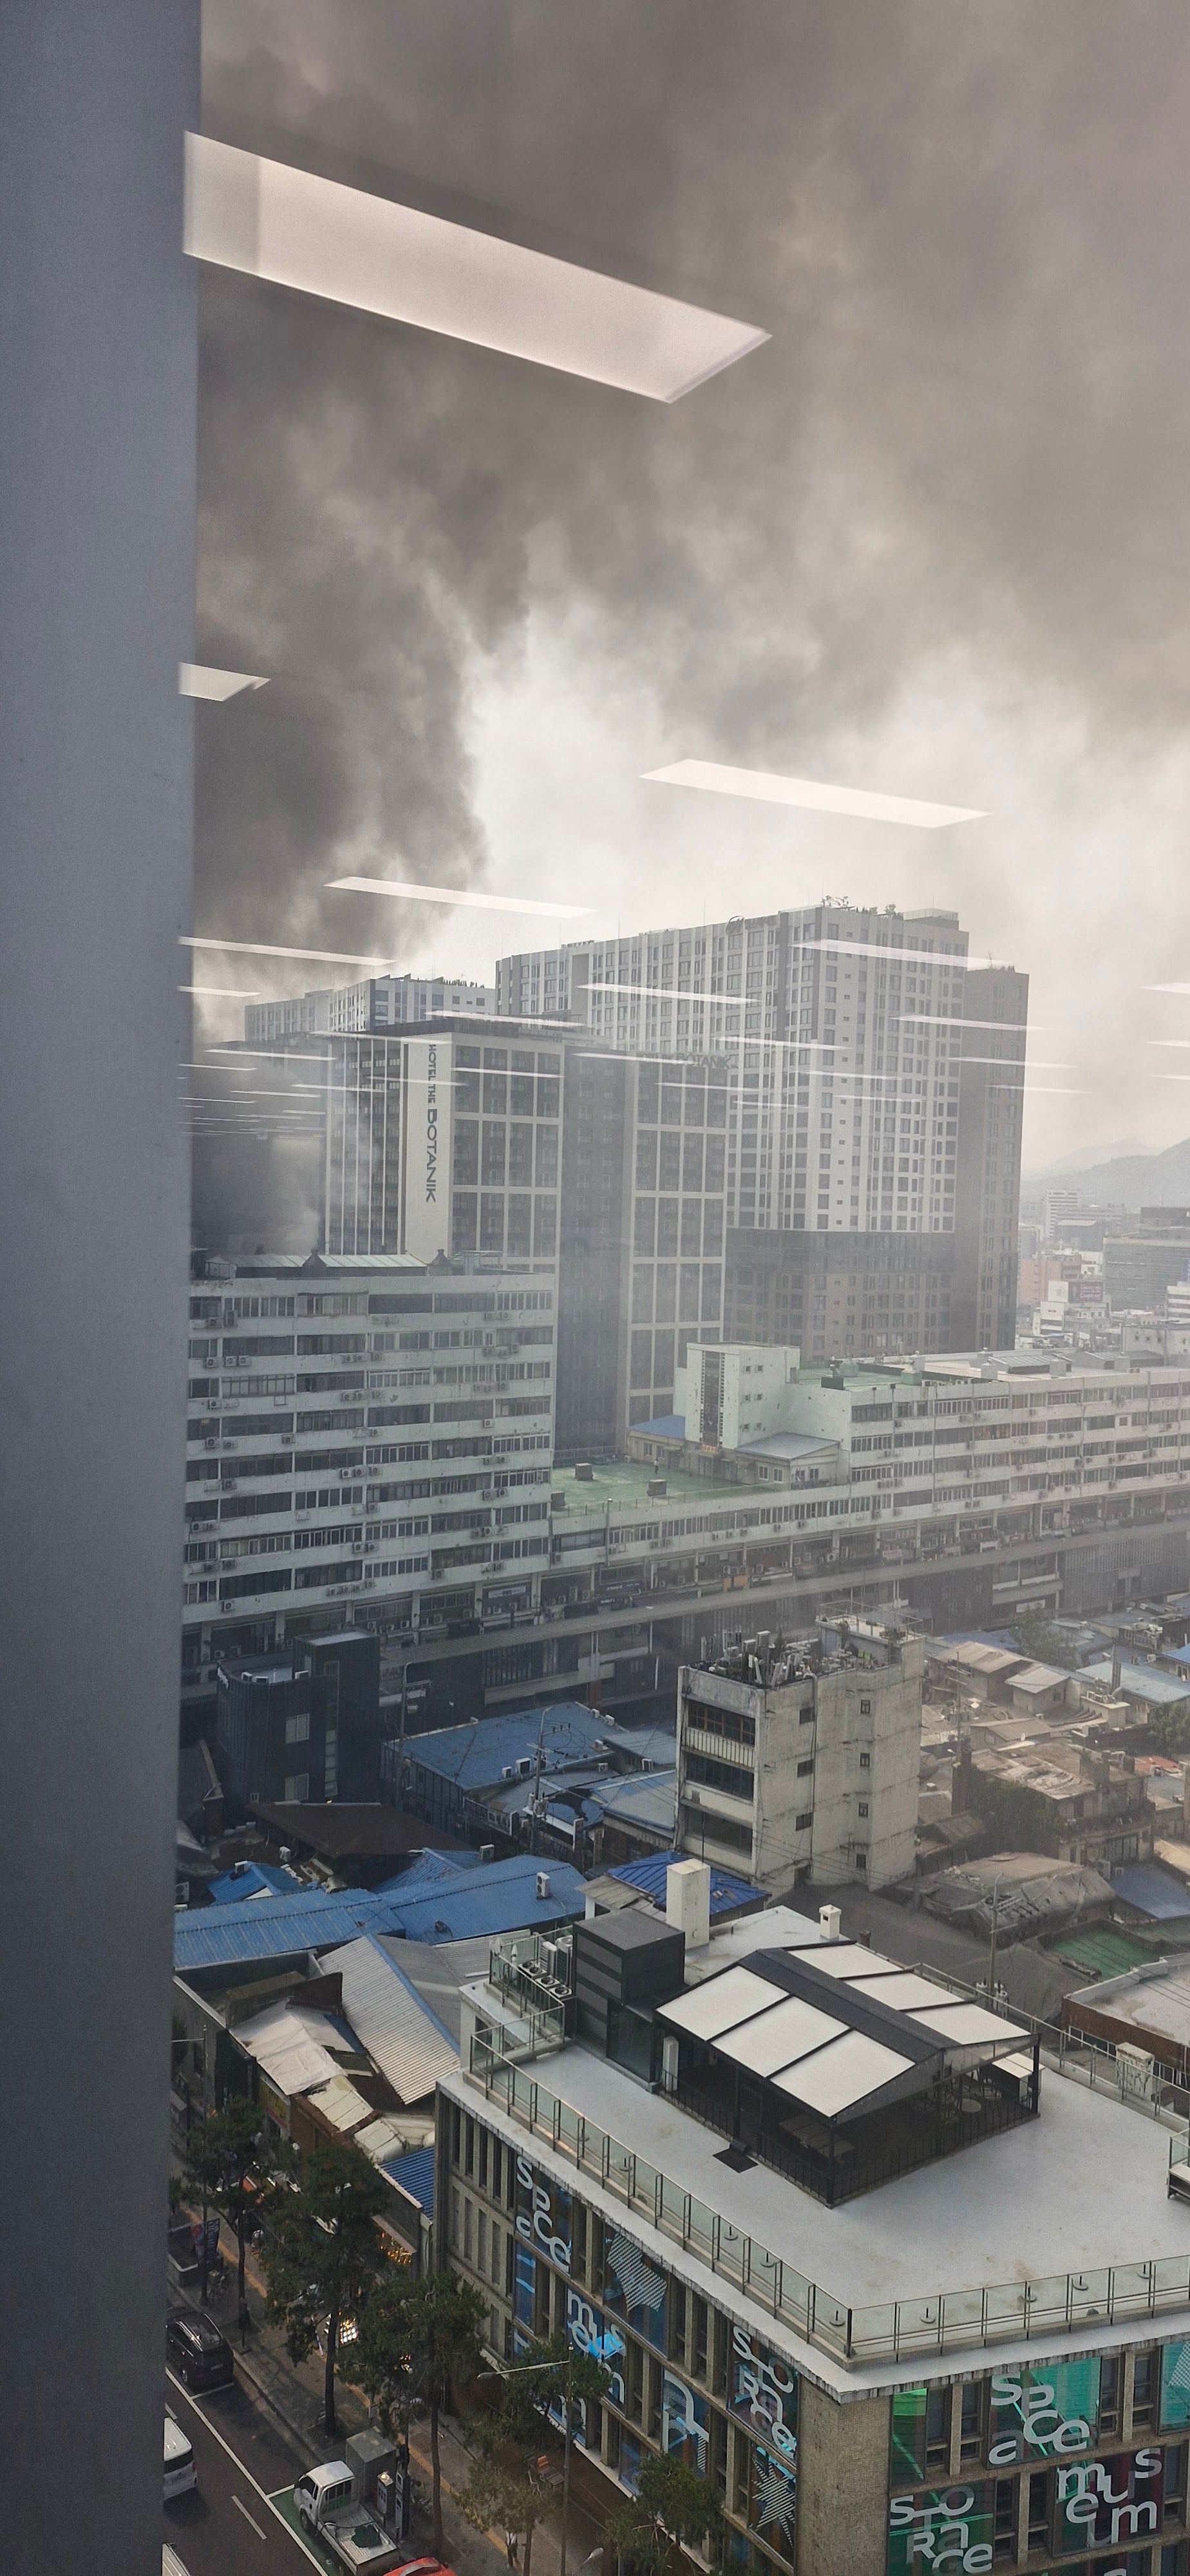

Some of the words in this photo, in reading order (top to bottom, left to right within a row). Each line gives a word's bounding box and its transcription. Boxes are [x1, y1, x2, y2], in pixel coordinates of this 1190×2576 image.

[428, 1044, 437, 1081] HOTEL
[428, 1083, 436, 1103] THE
[426, 1108, 437, 1202] BOTANIK
